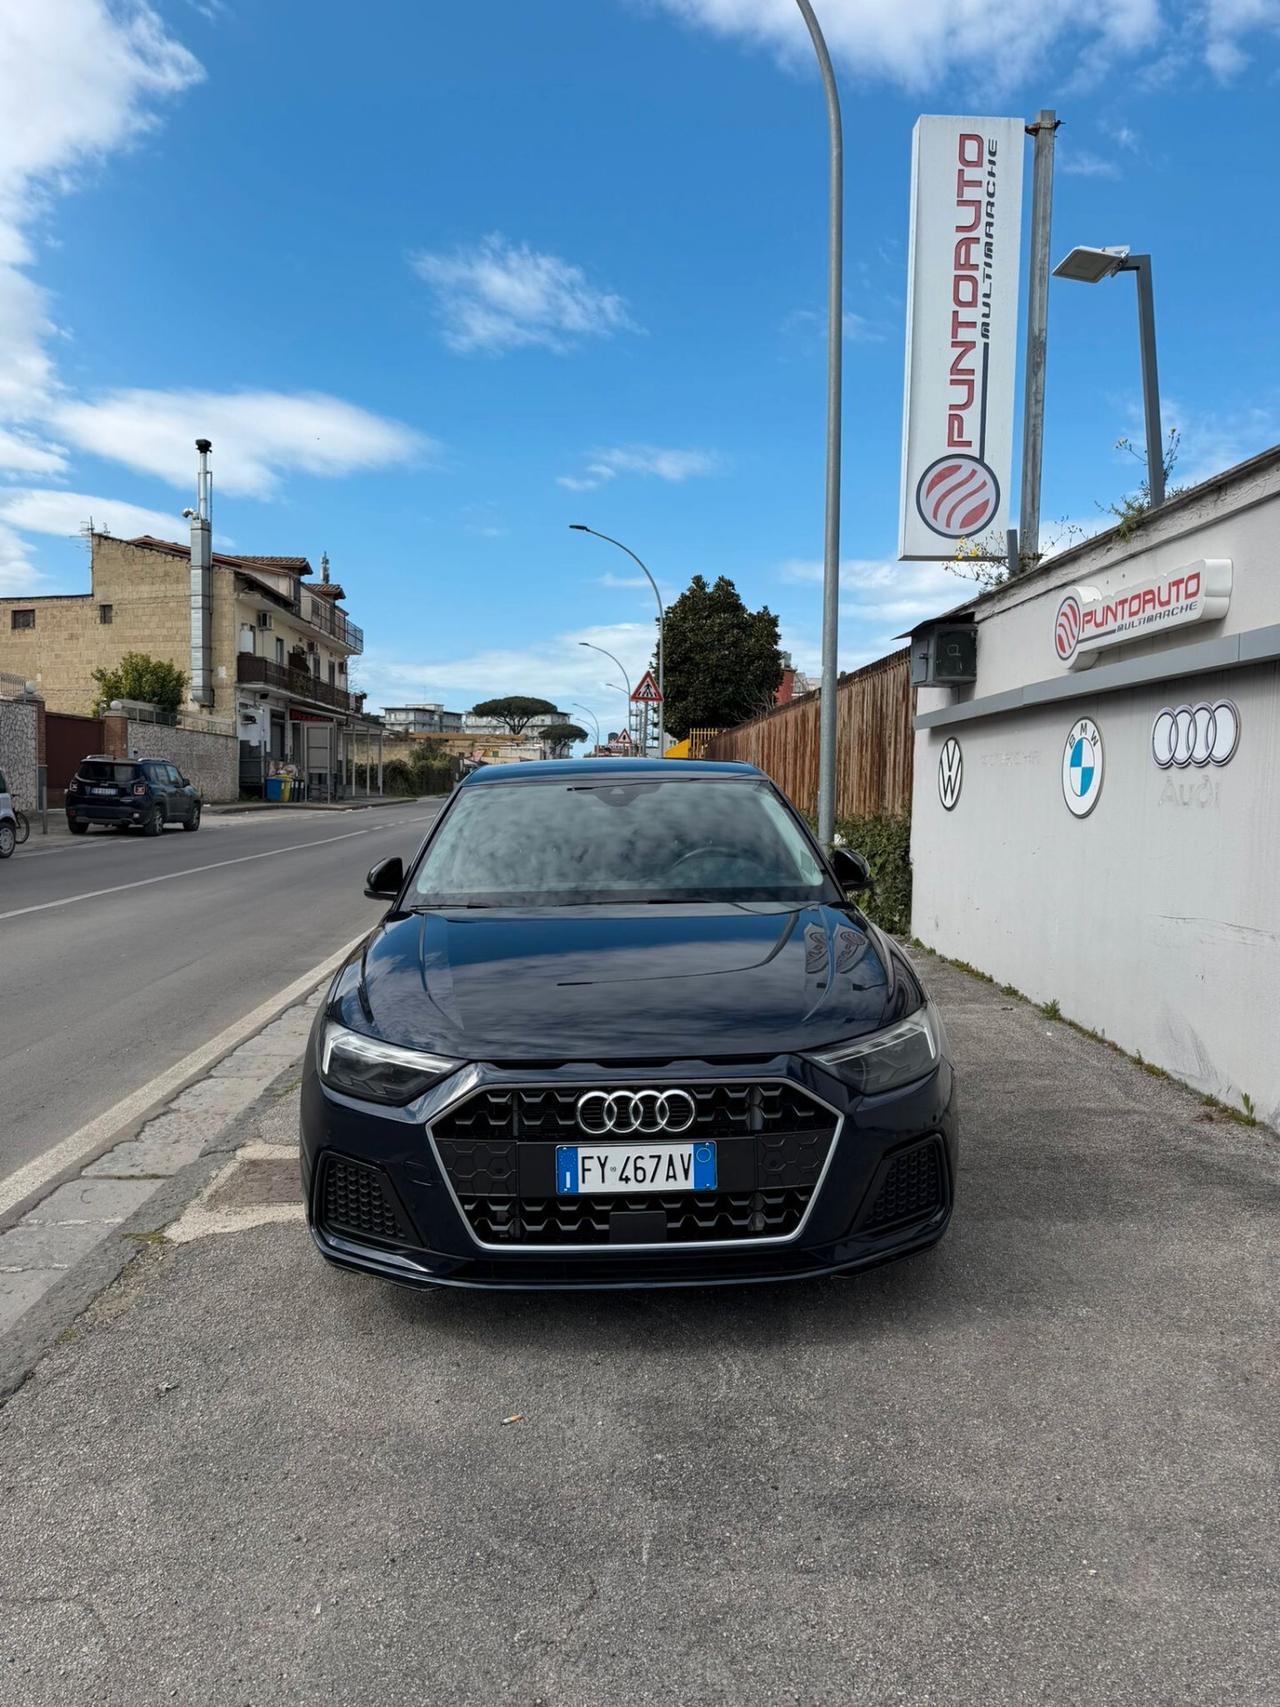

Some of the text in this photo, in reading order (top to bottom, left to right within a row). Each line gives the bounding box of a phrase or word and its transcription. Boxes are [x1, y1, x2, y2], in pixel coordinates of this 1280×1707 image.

[980, 138, 998, 340] MULTIMARCHE
[947, 133, 985, 448] PUNTOAUTO
[1081, 571, 1201, 633] PUNTOAUTO
[1116, 600, 1199, 633] MULTIMARCHE
[1068, 721, 1100, 750] BMW
